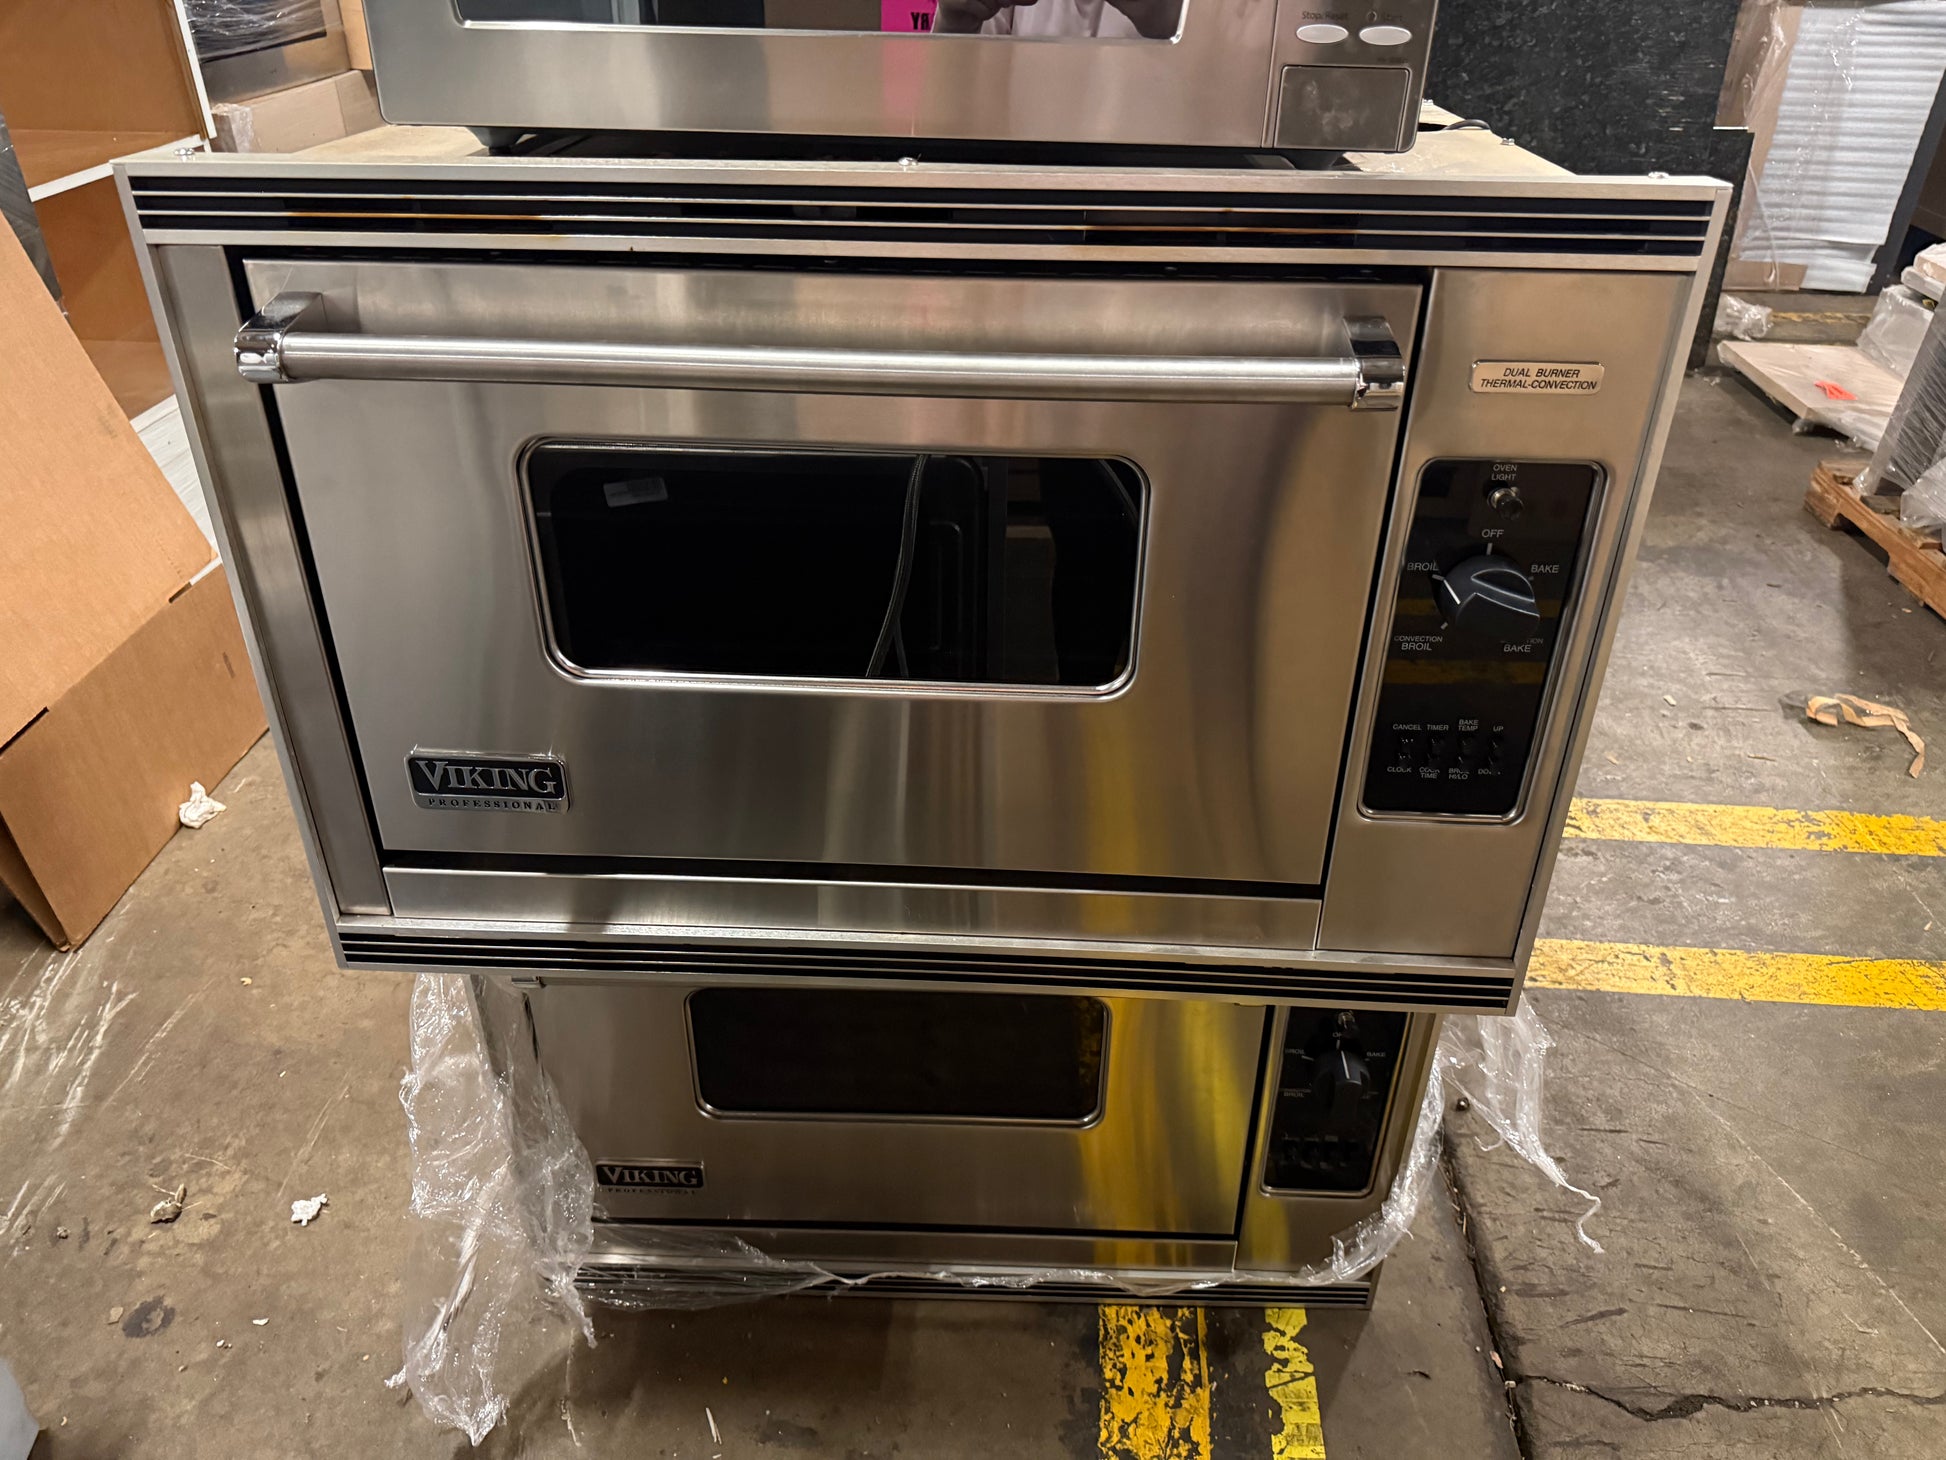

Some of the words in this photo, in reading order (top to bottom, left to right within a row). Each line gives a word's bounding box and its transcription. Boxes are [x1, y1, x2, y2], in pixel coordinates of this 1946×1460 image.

[1503, 368, 1531, 377] DUAL
[1535, 368, 1580, 378] BURNER
[1480, 378, 1598, 390] THERMAL-CONVECTION
[1493, 464, 1518, 472] OVEN
[1491, 473, 1517, 481] LIGHT
[1481, 529, 1504, 538] OFF
[1407, 562, 1439, 571] BROIL
[1530, 564, 1559, 573] BAKE
[1394, 635, 1443, 643] CONVECTION
[1401, 642, 1433, 651] BROIL
[1503, 644, 1532, 653] BAKE
[416, 760, 557, 794] VIKING
[428, 798, 556, 810] PROFESSIONAL
[601, 1166, 698, 1185] VIKING
